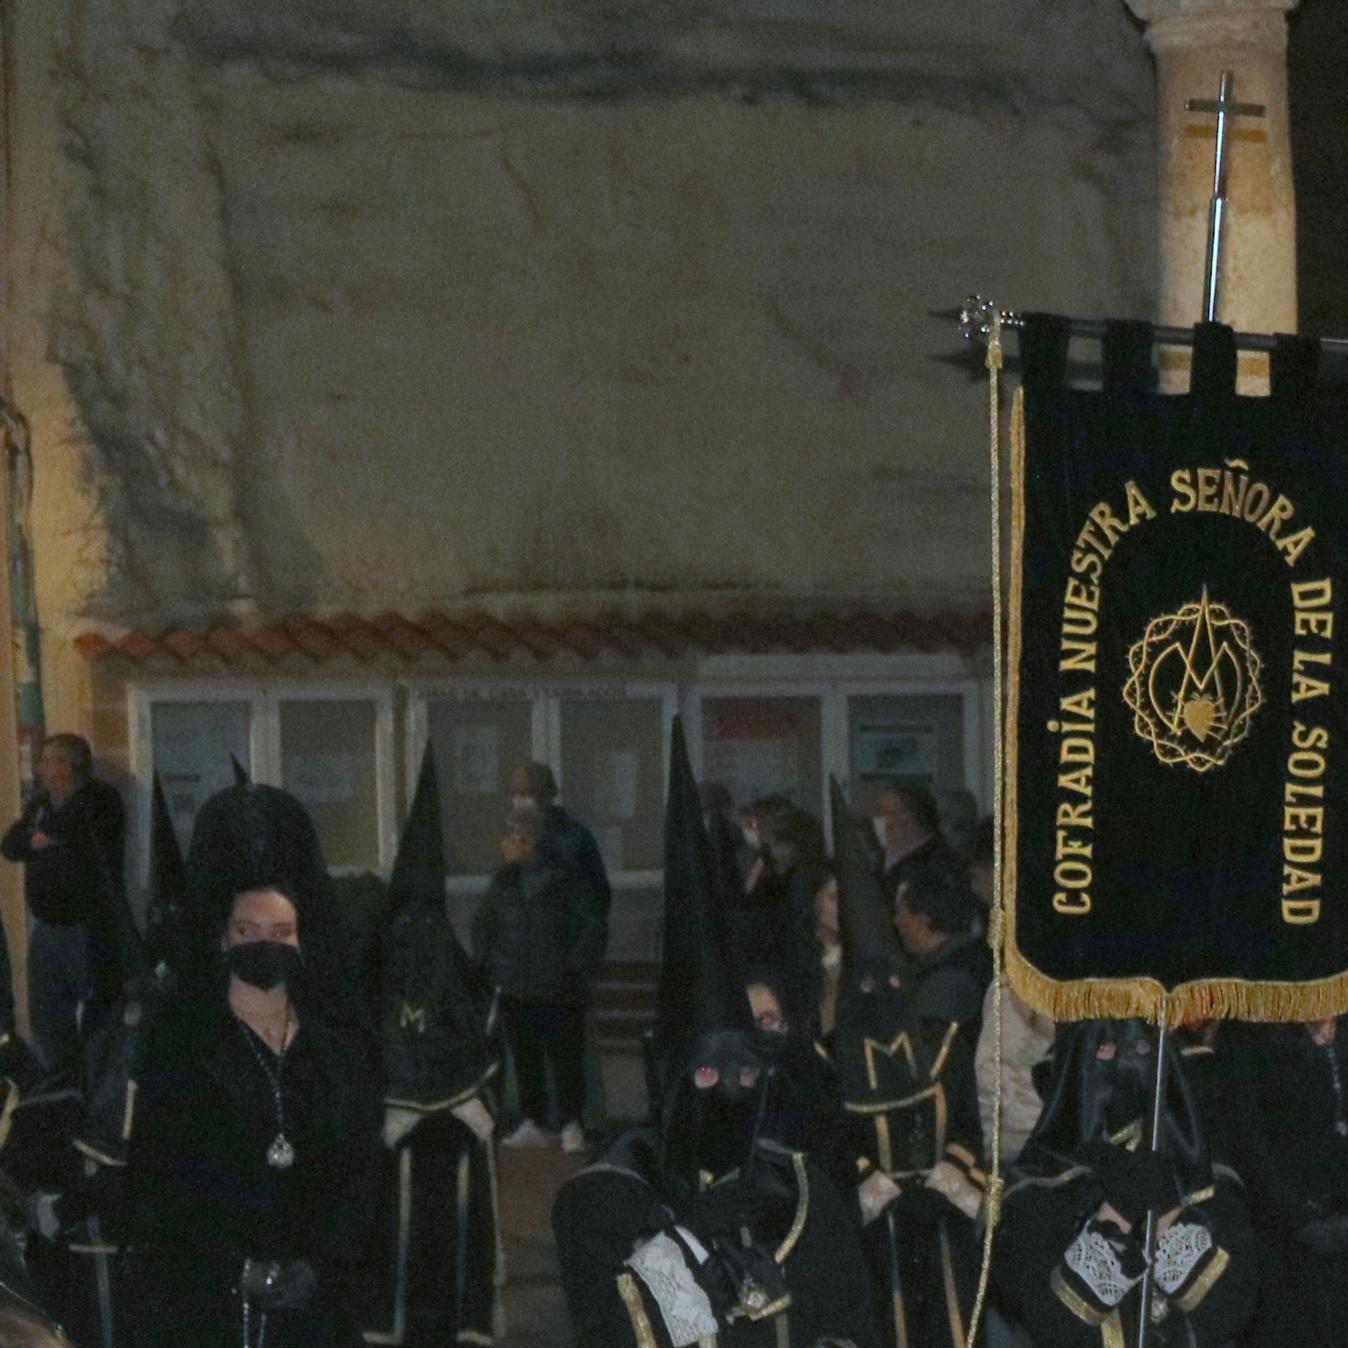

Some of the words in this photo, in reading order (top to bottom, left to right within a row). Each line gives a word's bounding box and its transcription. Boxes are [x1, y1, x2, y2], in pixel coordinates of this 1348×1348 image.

[1170, 458, 1315, 567] SEÑORA
[1060, 481, 1157, 673] NUESTRA
[1290, 578, 1334, 639] DE
[1291, 650, 1332, 704] LA
[1281, 720, 1329, 925] SOLEDAD
